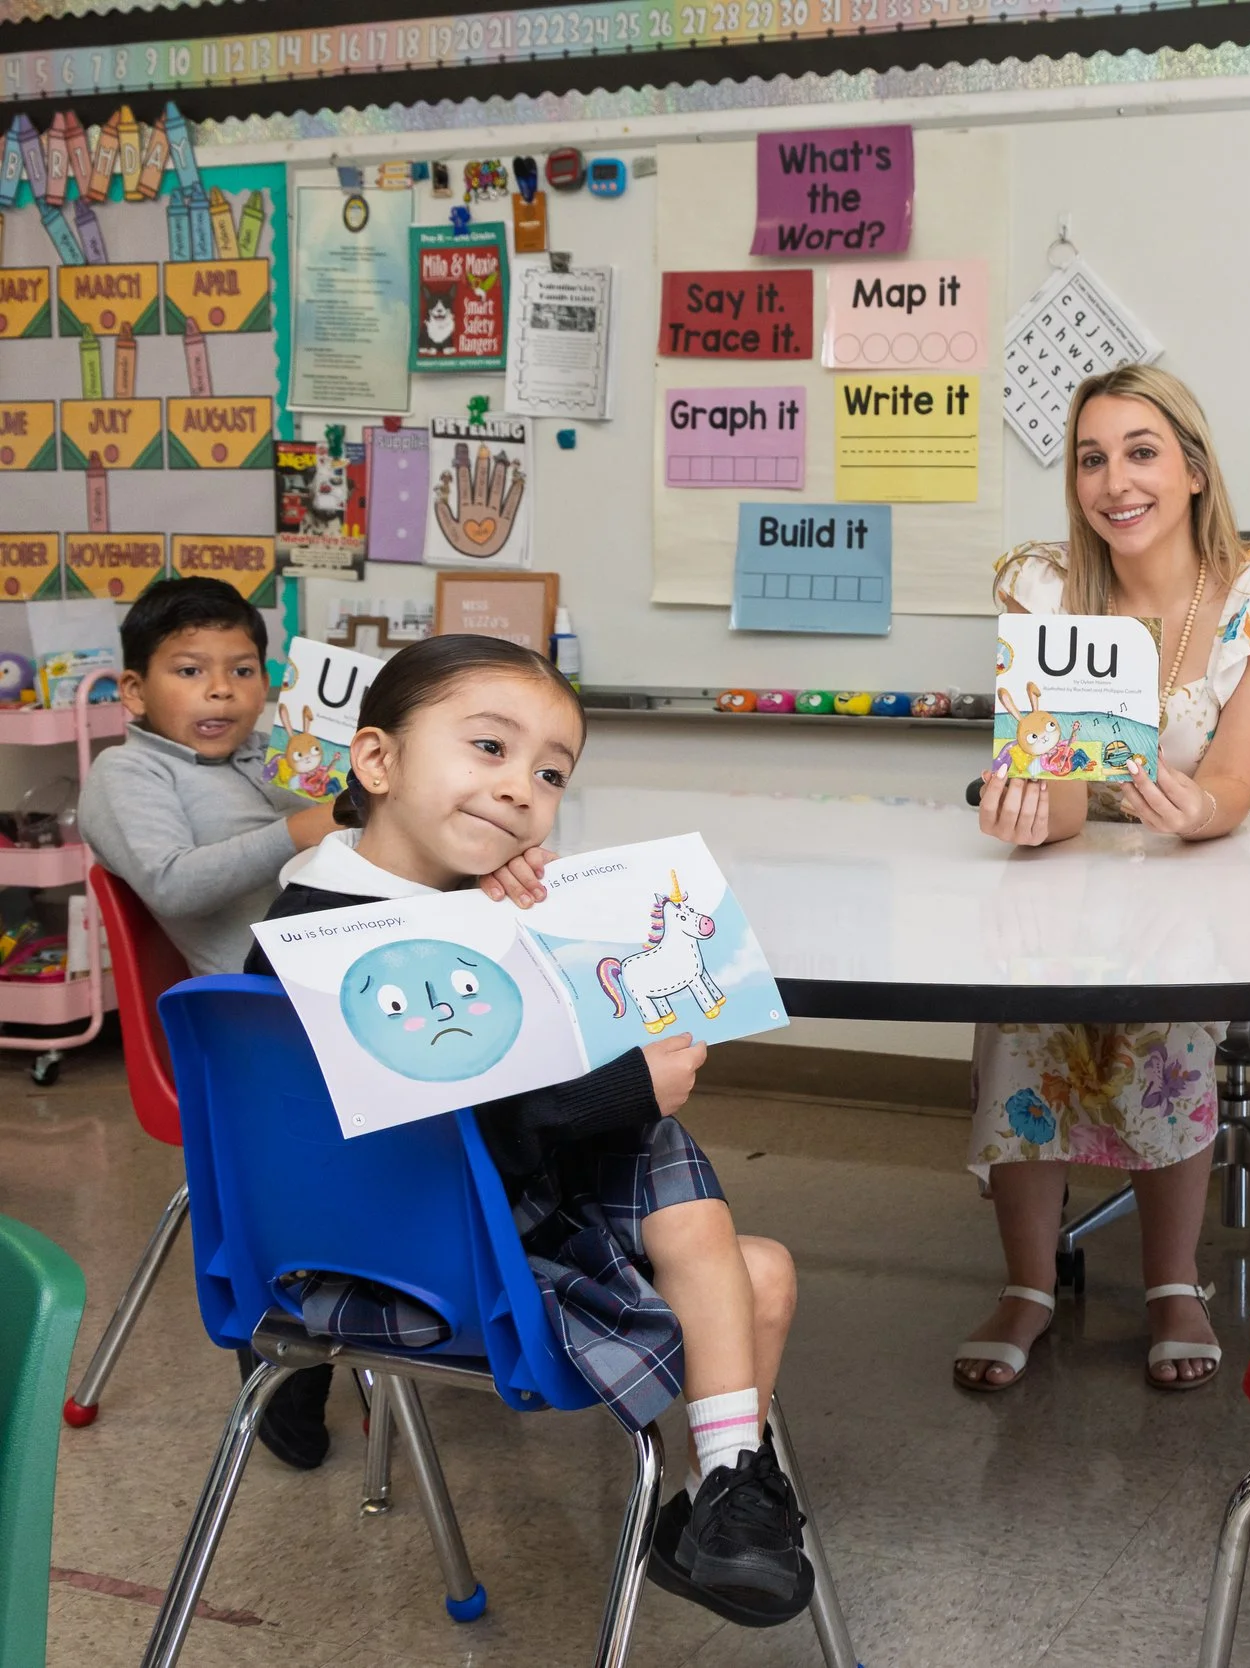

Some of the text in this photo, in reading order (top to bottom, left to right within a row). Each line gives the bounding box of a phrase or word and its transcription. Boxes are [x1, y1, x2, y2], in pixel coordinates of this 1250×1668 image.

[7, 59, 20, 87] 4
[35, 58, 48, 85] 5
[62, 57, 74, 85] 6
[91, 55, 101, 82] 7
[115, 50, 127, 79] 8
[146, 48, 157, 75] 9
[168, 46, 190, 77] 10
[202, 43, 217, 75] 11
[225, 41, 245, 72] 12
[251, 38, 271, 69] 13
[278, 35, 302, 67] 14
[311, 32, 332, 64] 15
[340, 31, 361, 63] 16
[368, 29, 387, 61] 17
[397, 27, 420, 59] 18
[429, 25, 451, 57] 19
[455, 20, 484, 50] 20
[488, 17, 512, 48] 21
[517, 15, 548, 47] 22
[551, 12, 580, 44] 23
[582, 17, 609, 44] 24
[616, 12, 640, 39] 25
[649, 9, 672, 37] 26
[682, 7, 706, 34] 27
[712, 2, 740, 32] 28
[747, 0, 773, 28] 29
[780, 0, 807, 26] 30
[821, 0, 840, 24] 31
[852, 0, 877, 21] 32
[778, 140, 892, 175] What's
[807, 183, 861, 214] the
[778, 221, 885, 252] Word?
[422, 254, 448, 278] Milo
[450, 253, 463, 277] &
[0, 276, 43, 304] ARY
[74, 272, 141, 300] MARCH
[192, 268, 241, 297] APRIL
[852, 275, 961, 315] Map it
[463, 297, 494, 315] Smart
[686, 283, 785, 320] Say it.
[463, 316, 496, 336] Safety
[669, 323, 801, 353] Trace it.
[1061, 295, 1115, 357] c q j m
[459, 334, 498, 356] Rangers
[1042, 314, 1095, 373] n h w b
[1024, 330, 1075, 392] k v s x
[1007, 349, 1016, 359] t
[1018, 365, 1029, 375] d
[1028, 377, 1038, 389] y
[1051, 404, 1060, 413] r
[843, 384, 970, 416] Write it
[88, 407, 132, 434] JULY
[183, 406, 257, 433] AUGUST
[434, 418, 523, 439] RETELLING
[670, 400, 799, 436] Graph it
[1016, 401, 1026, 413] i
[1029, 419, 1038, 429] o
[1042, 433, 1053, 446] u
[378, 435, 429, 453] supplie
[759, 516, 868, 549] Build it
[69, 543, 161, 568] NOVEMBER
[180, 544, 266, 571] DECEMBER
[1038, 625, 1118, 678] Uu
[548, 863, 628, 889] is for unicorn.
[280, 916, 406, 943] Uu is for unhappy.
